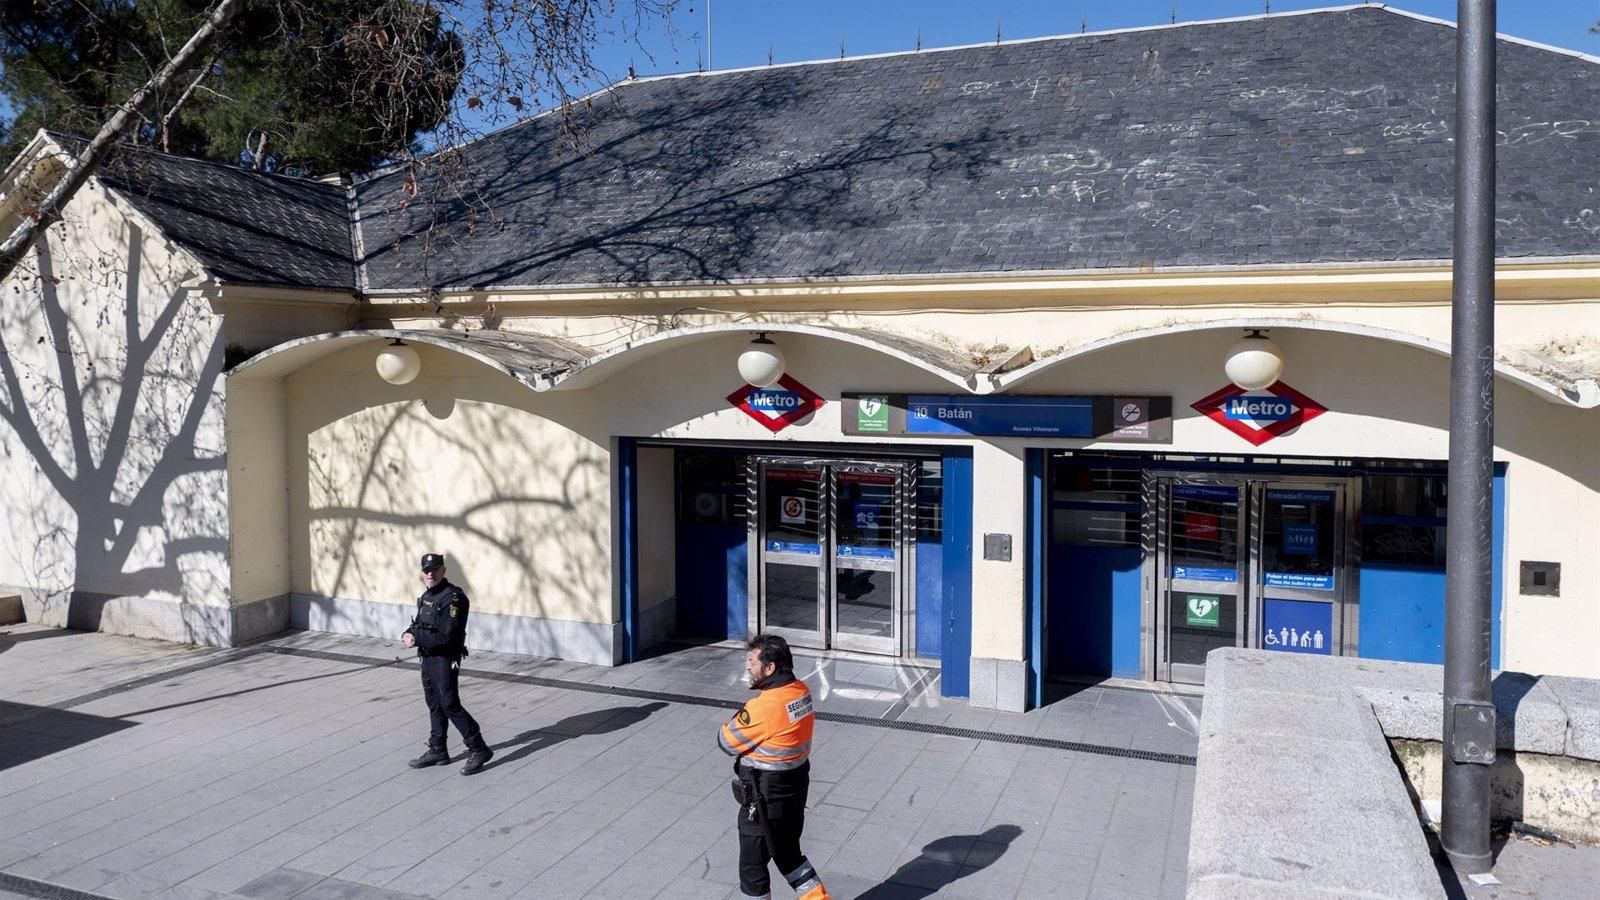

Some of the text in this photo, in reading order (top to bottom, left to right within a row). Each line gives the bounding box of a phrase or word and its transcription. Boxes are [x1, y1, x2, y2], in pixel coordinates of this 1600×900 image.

[754, 393, 795, 407] Metro
[1231, 399, 1287, 415] Metro
[916, 407, 973, 419] 10 Batán
